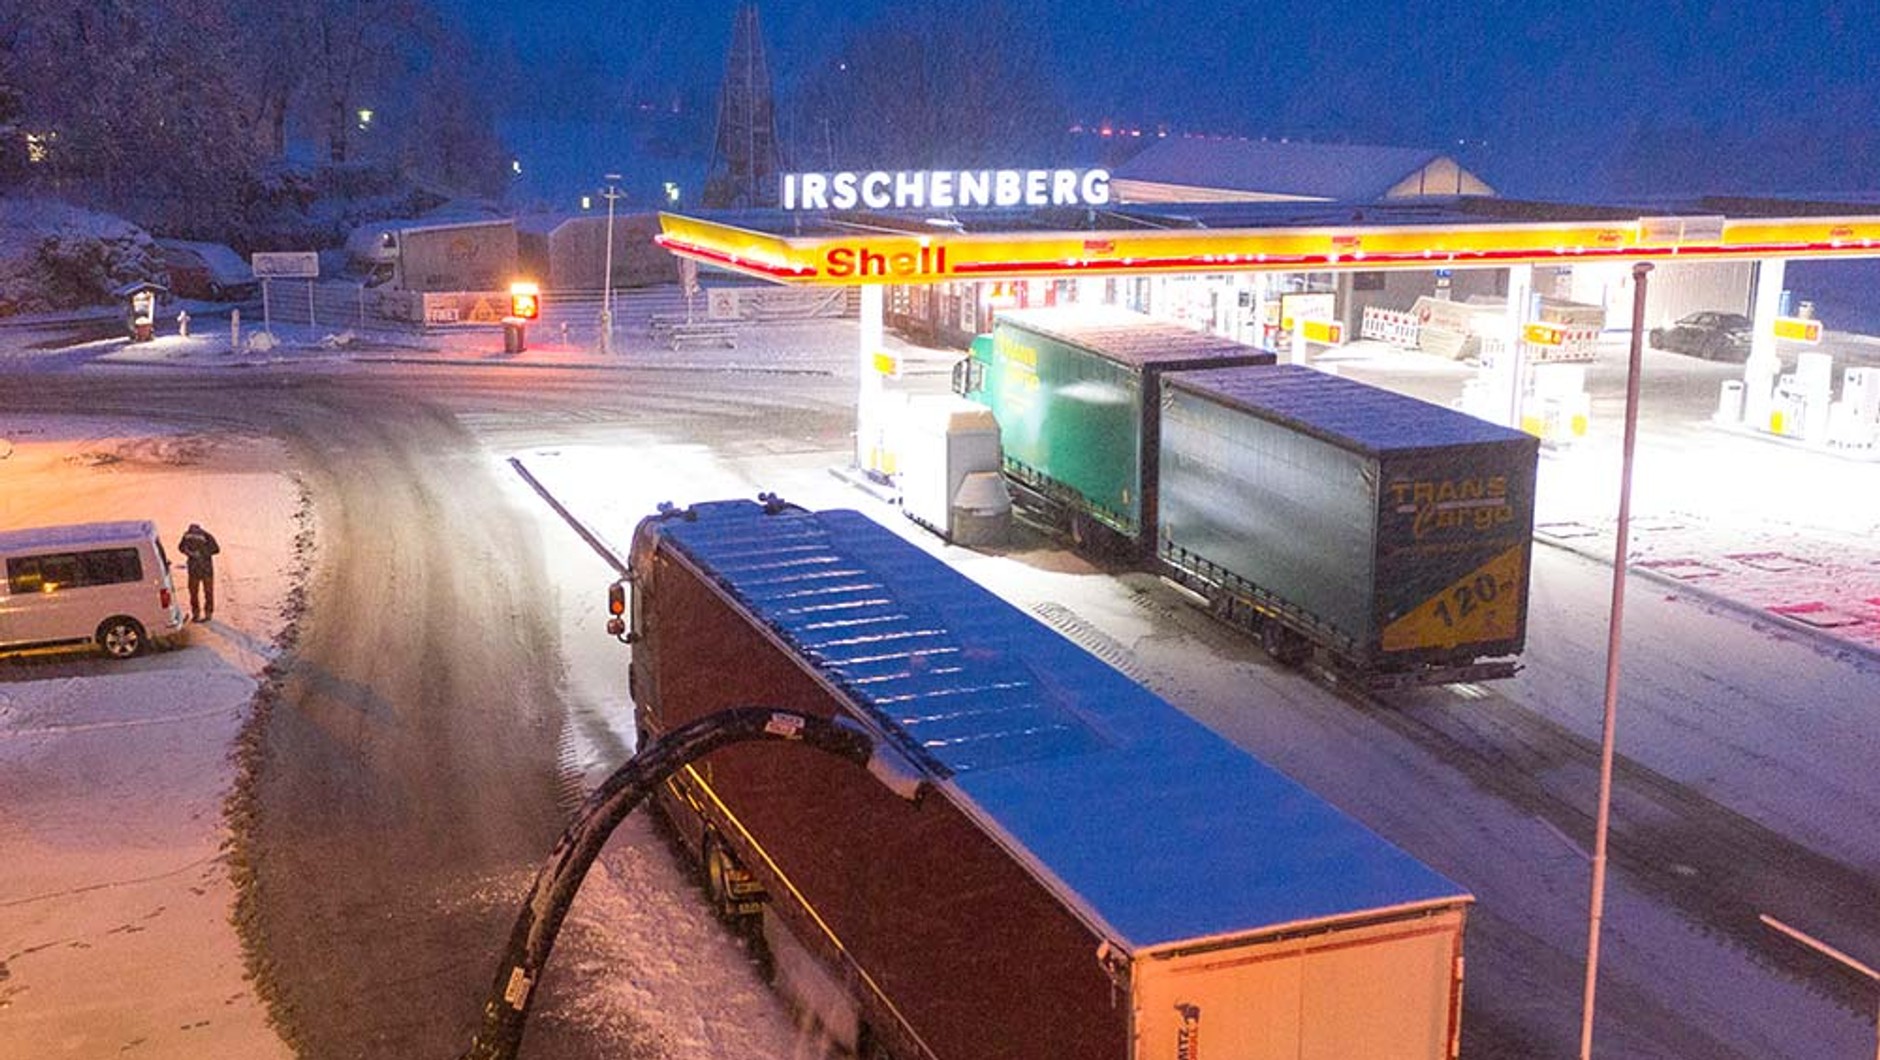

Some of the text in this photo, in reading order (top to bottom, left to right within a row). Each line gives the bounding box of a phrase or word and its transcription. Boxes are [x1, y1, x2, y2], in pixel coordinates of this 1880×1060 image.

[783, 169, 1111, 210] IRSCHENBERG
[826, 246, 946, 277] Shell
[1389, 476, 1505, 505] TRANS
[1433, 574, 1498, 628] 120
